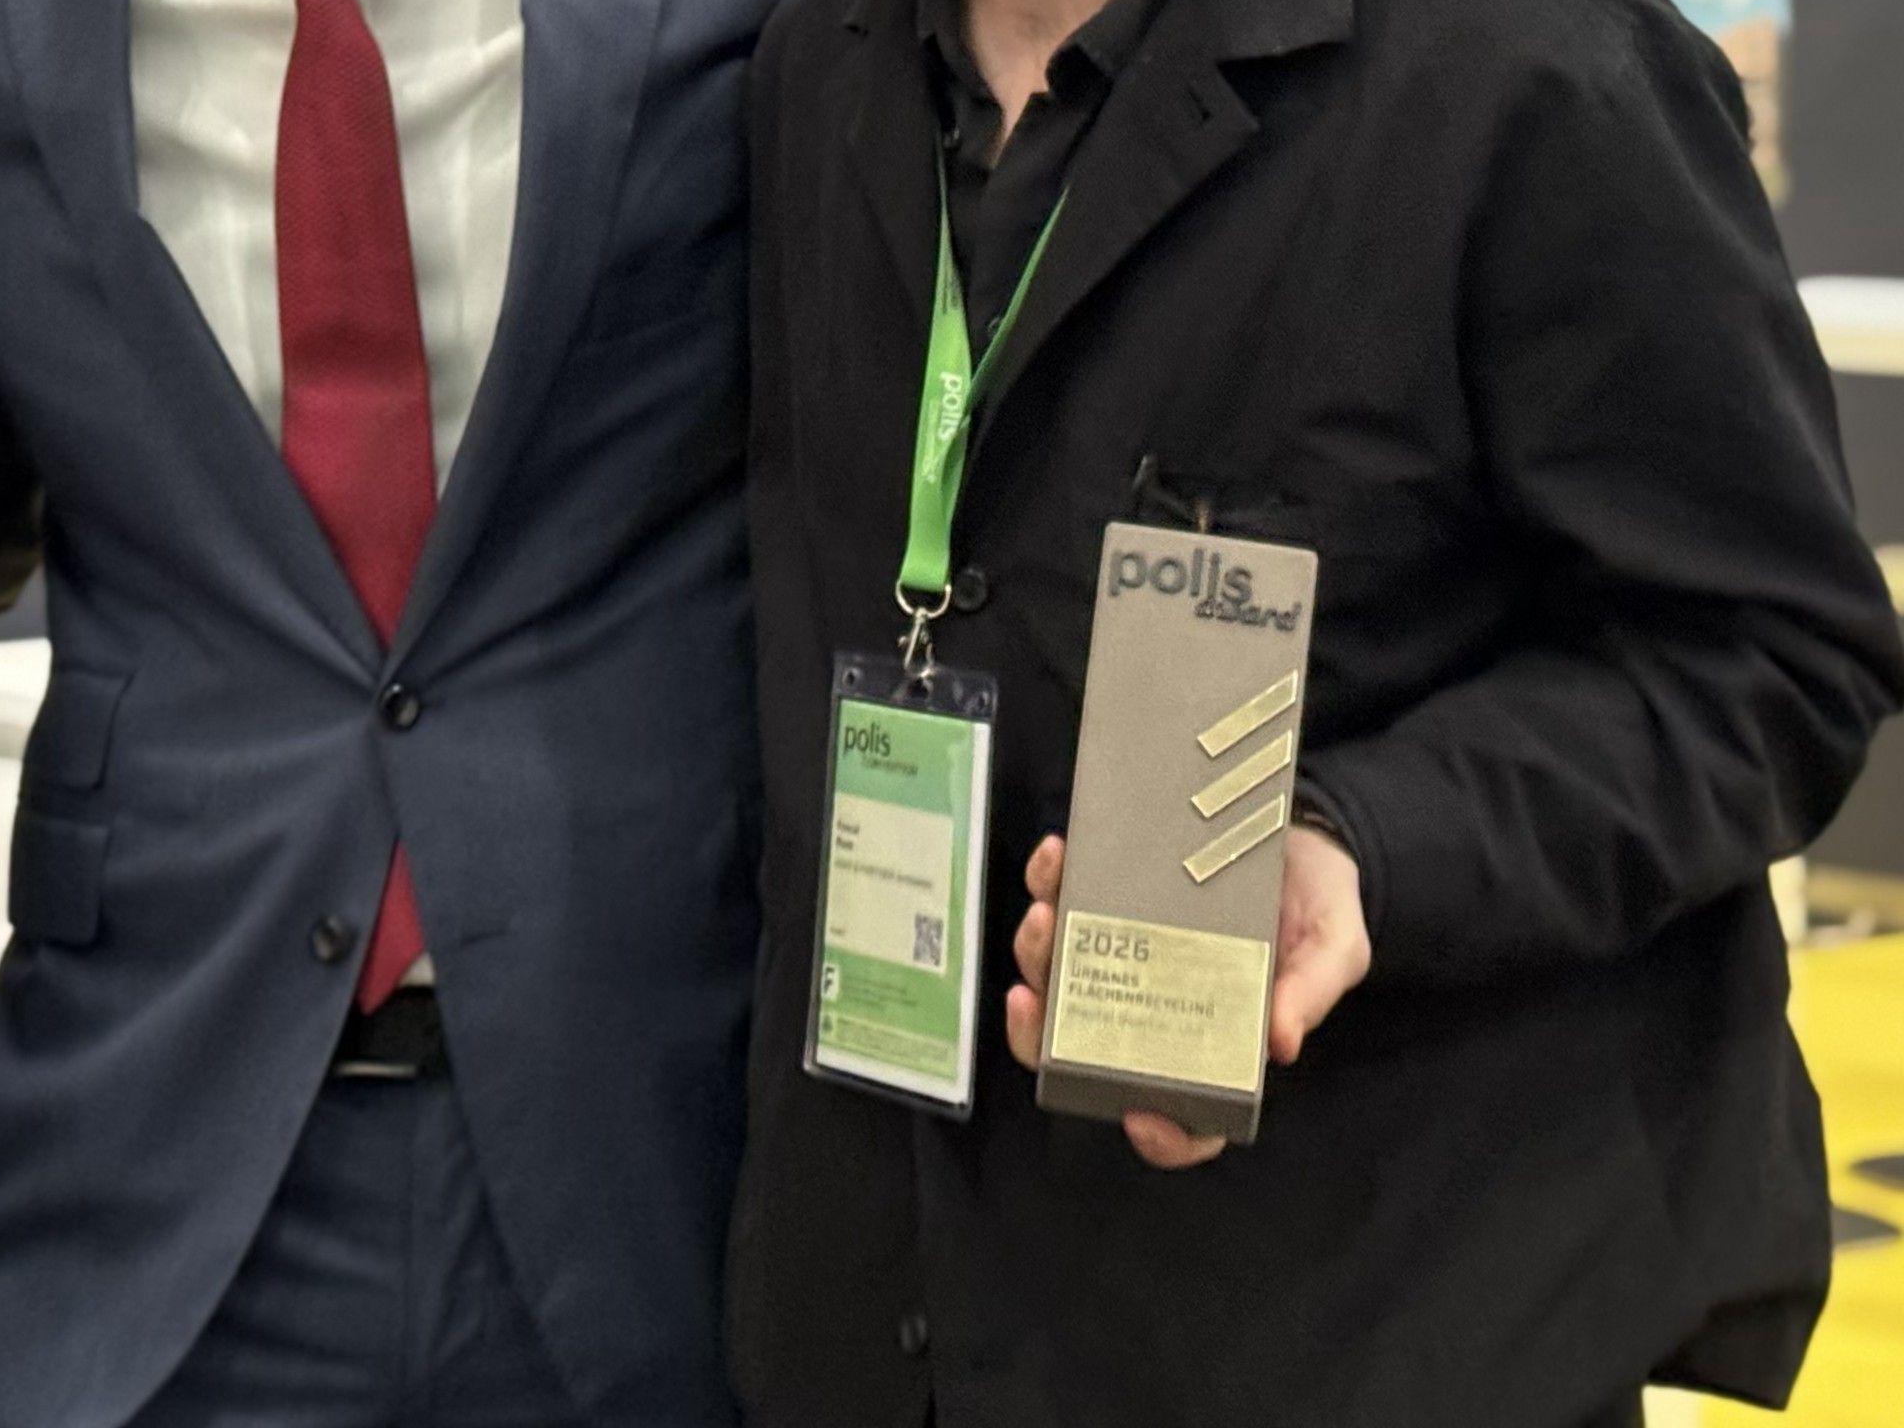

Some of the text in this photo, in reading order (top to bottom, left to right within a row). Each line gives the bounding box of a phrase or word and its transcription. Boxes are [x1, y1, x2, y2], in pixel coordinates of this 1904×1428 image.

[1108, 547, 1253, 604] polis
[843, 723, 892, 759] polis
[1075, 928, 1150, 962] 2026
